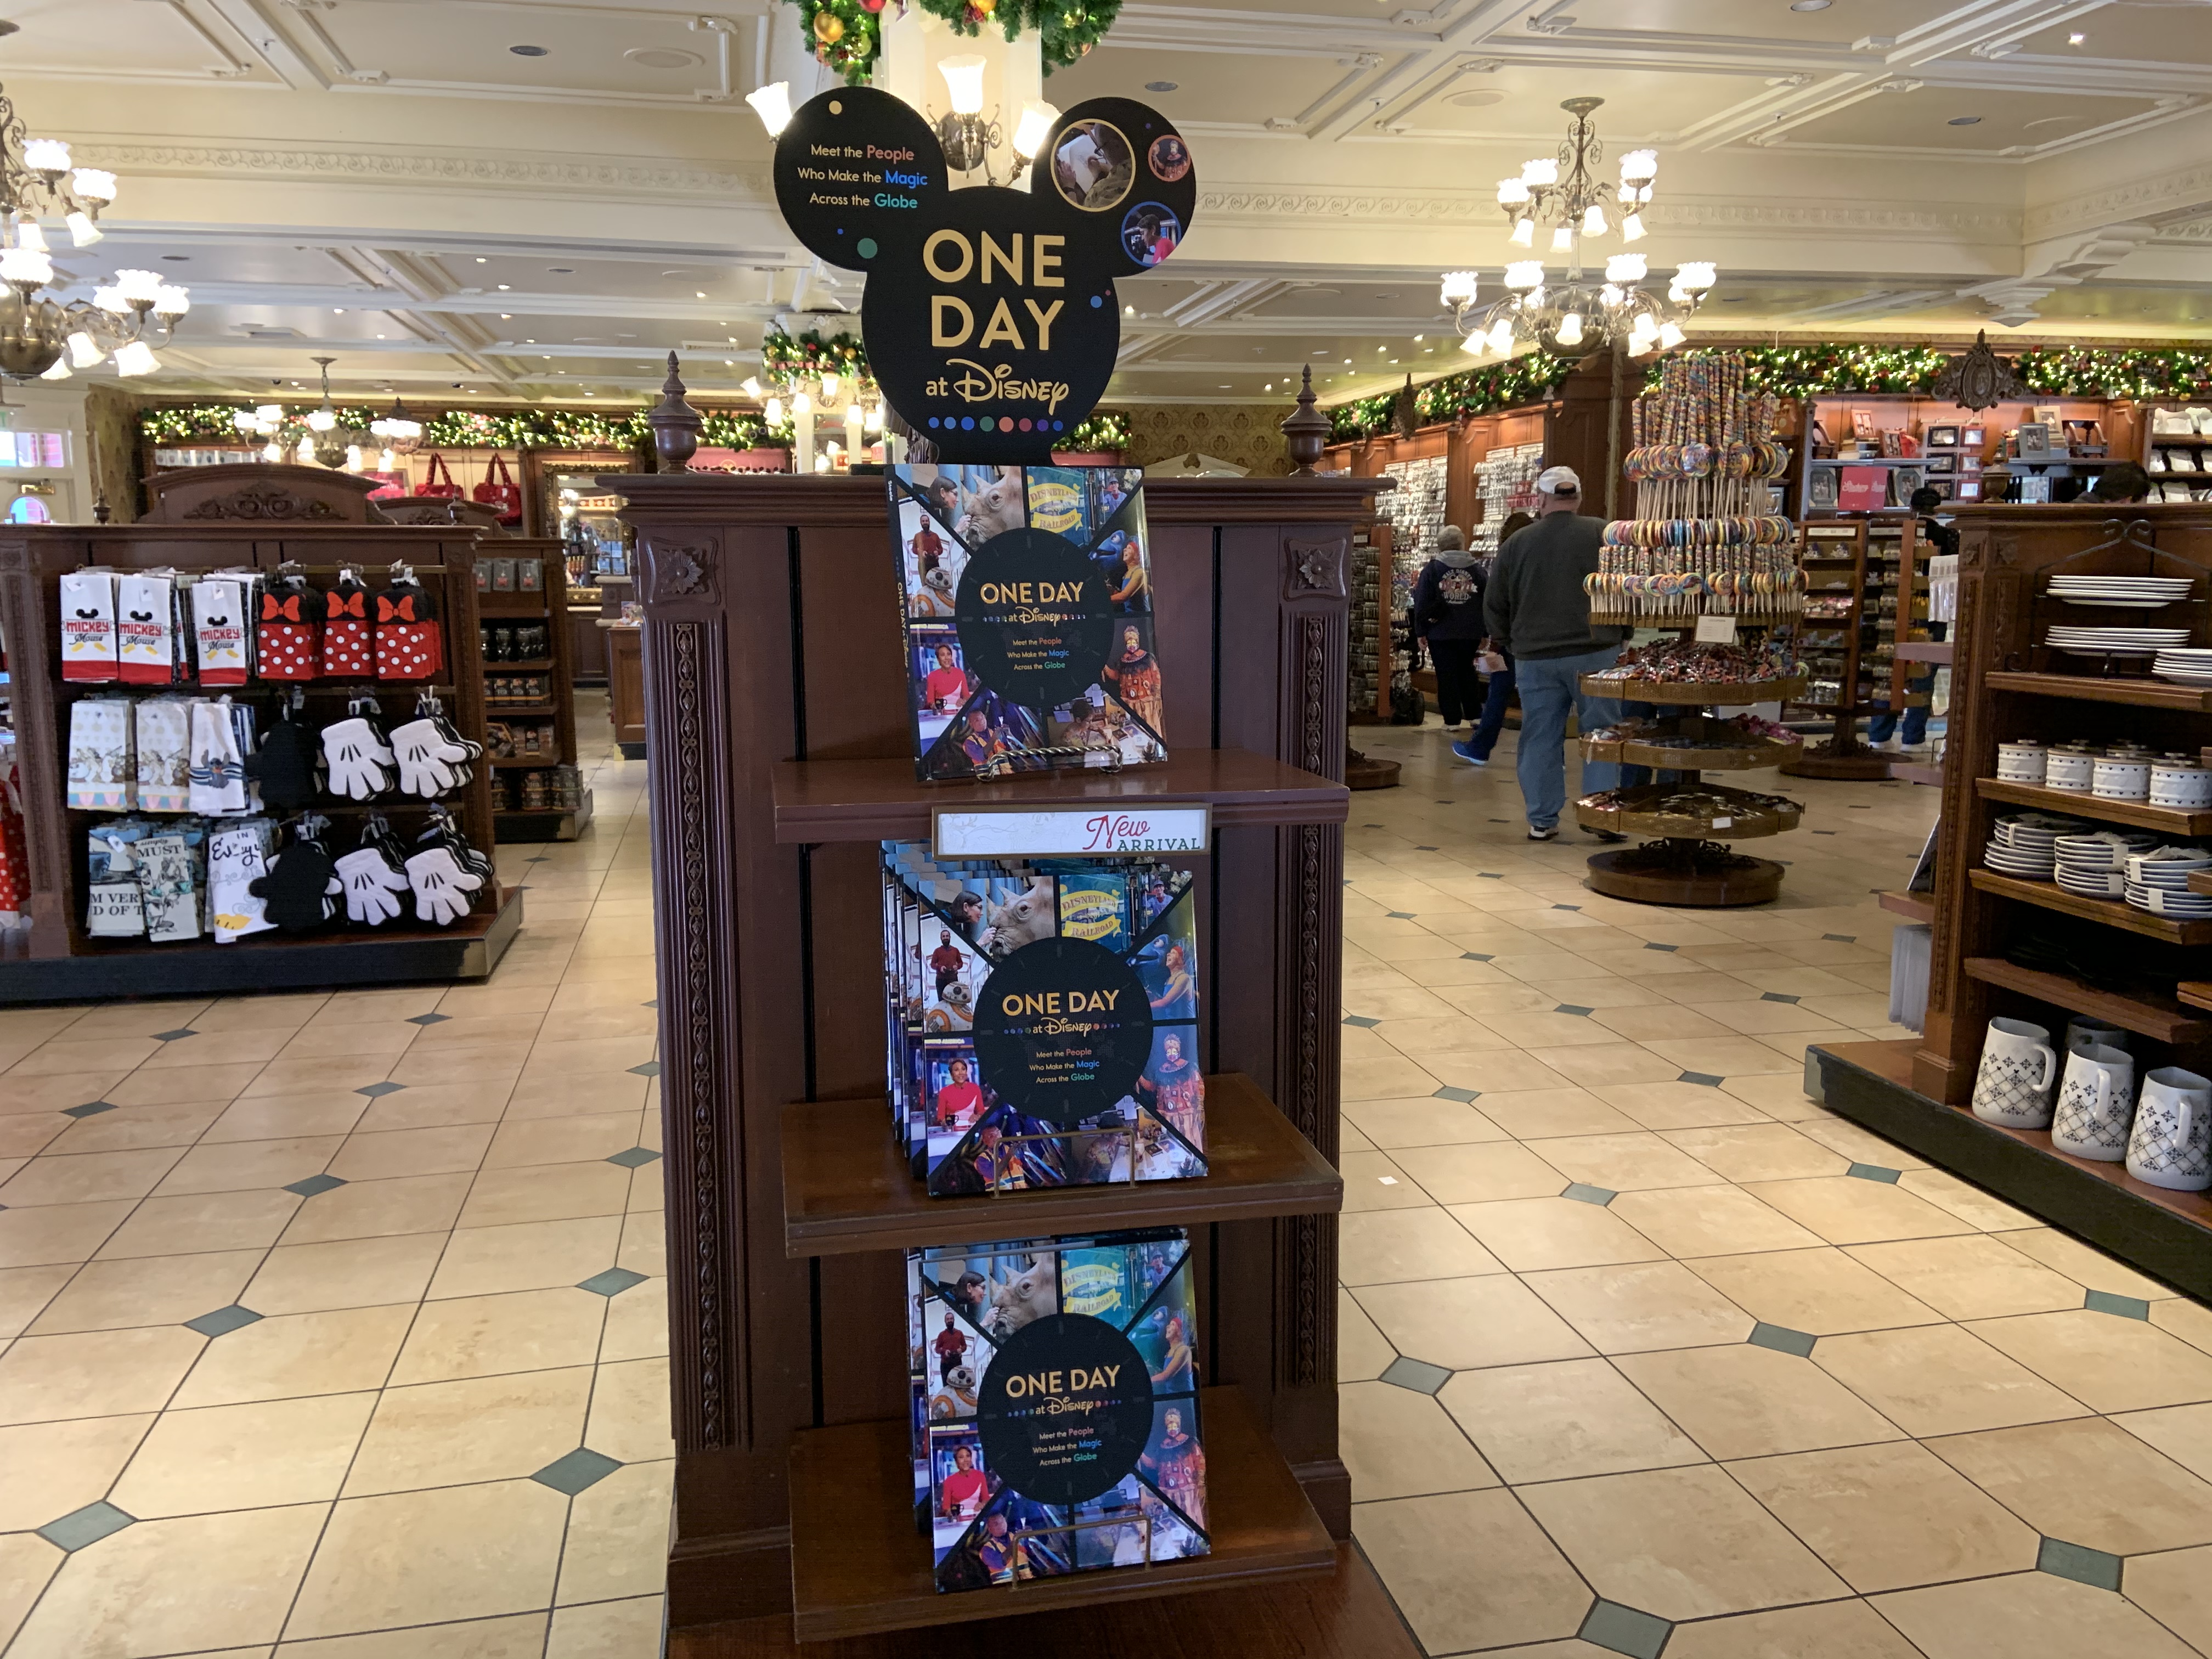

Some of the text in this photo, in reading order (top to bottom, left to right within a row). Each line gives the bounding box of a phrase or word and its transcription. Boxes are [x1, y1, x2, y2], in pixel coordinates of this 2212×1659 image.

[811, 144, 914, 164] Meet the People
[798, 167, 927, 189] Who Make the Magic
[810, 193, 917, 208] Across the Globe
[923, 229, 1065, 287] ONE
[932, 295, 1064, 351] DAY
[926, 358, 1069, 416] at Disney
[980, 582, 1084, 603] ONE DAY
[1443, 592, 1469, 600] WORLD
[1009, 606, 1060, 627] at Disney
[1039, 637, 1062, 646] People
[1049, 650, 1069, 658] Magic
[1082, 815, 1150, 850] New
[137, 844, 181, 857] MUST
[1117, 838, 1200, 851] ARRIVAL
[109, 905, 129, 916] OF
[1071, 921, 1113, 937] RAILROAD
[1002, 990, 1119, 1016] ONE DAY
[1032, 1017, 1092, 1037] at Disney
[1066, 1048, 1092, 1058] People
[1076, 1060, 1100, 1069] Magic
[1006, 1365, 1120, 1398] ONE DAY
[1036, 1396, 1093, 1417] at Disney
[1069, 1427, 1094, 1437] People
[1079, 1440, 1102, 1449] Magic
[1074, 1453, 1097, 1462] Globe
